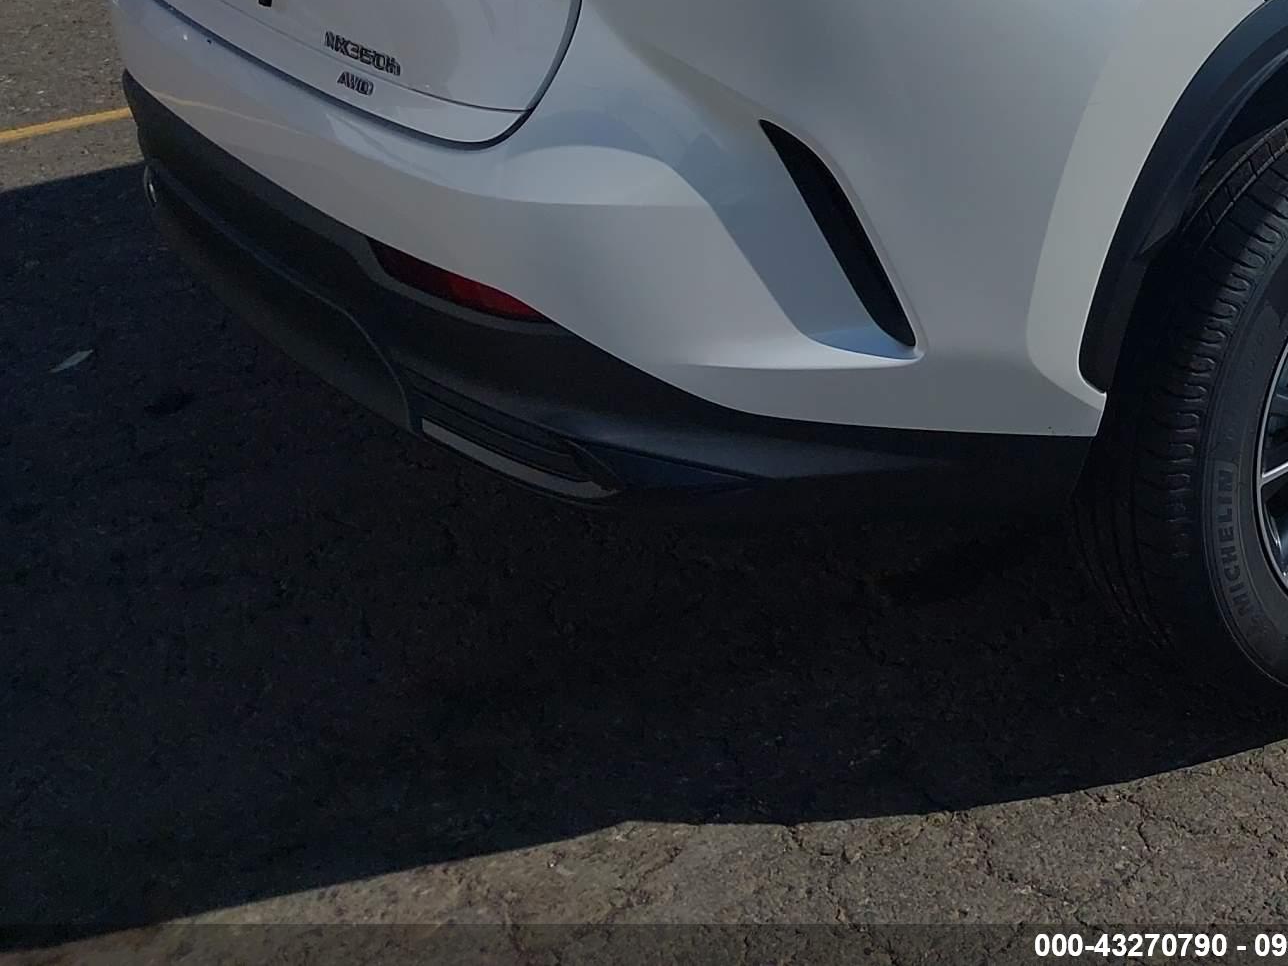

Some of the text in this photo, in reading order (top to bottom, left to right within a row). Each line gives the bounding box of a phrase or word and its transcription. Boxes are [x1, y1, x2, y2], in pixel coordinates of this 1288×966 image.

[325, 30, 401, 76] NX350h
[337, 71, 374, 96] AWD
[1216, 469, 1257, 618] MICHELIN
